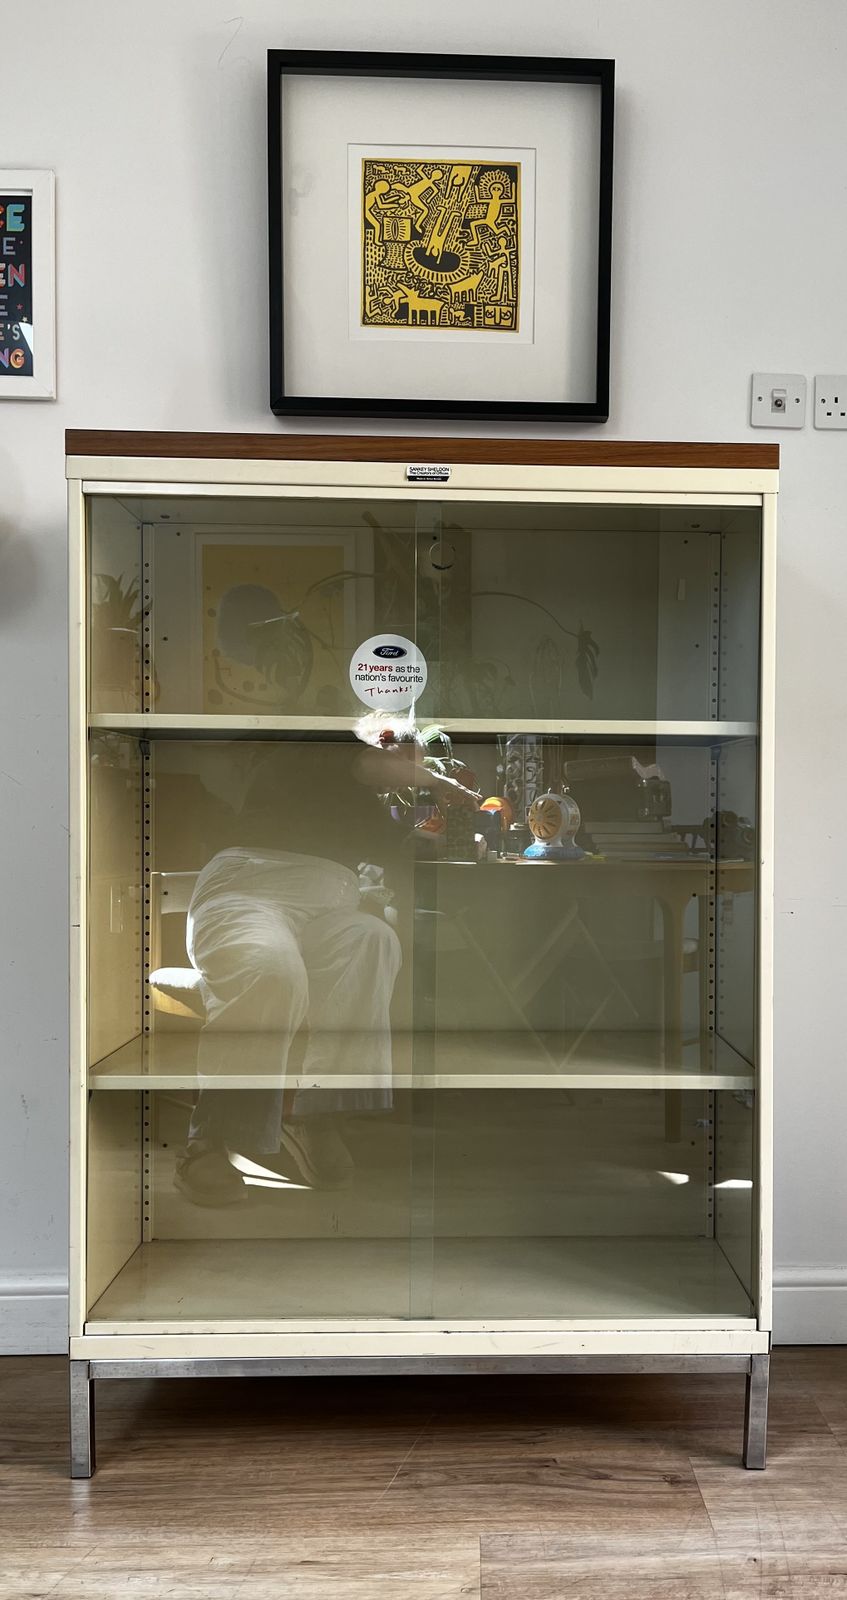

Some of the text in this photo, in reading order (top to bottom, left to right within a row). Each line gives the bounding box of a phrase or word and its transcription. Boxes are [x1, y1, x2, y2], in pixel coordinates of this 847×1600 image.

[0, 204, 25, 231] E
[379, 647, 399, 656] Ford
[358, 663, 368, 671] 21
[369, 665, 393, 673] years
[407, 665, 420, 673] the
[355, 673, 424, 683] nation's favourite
